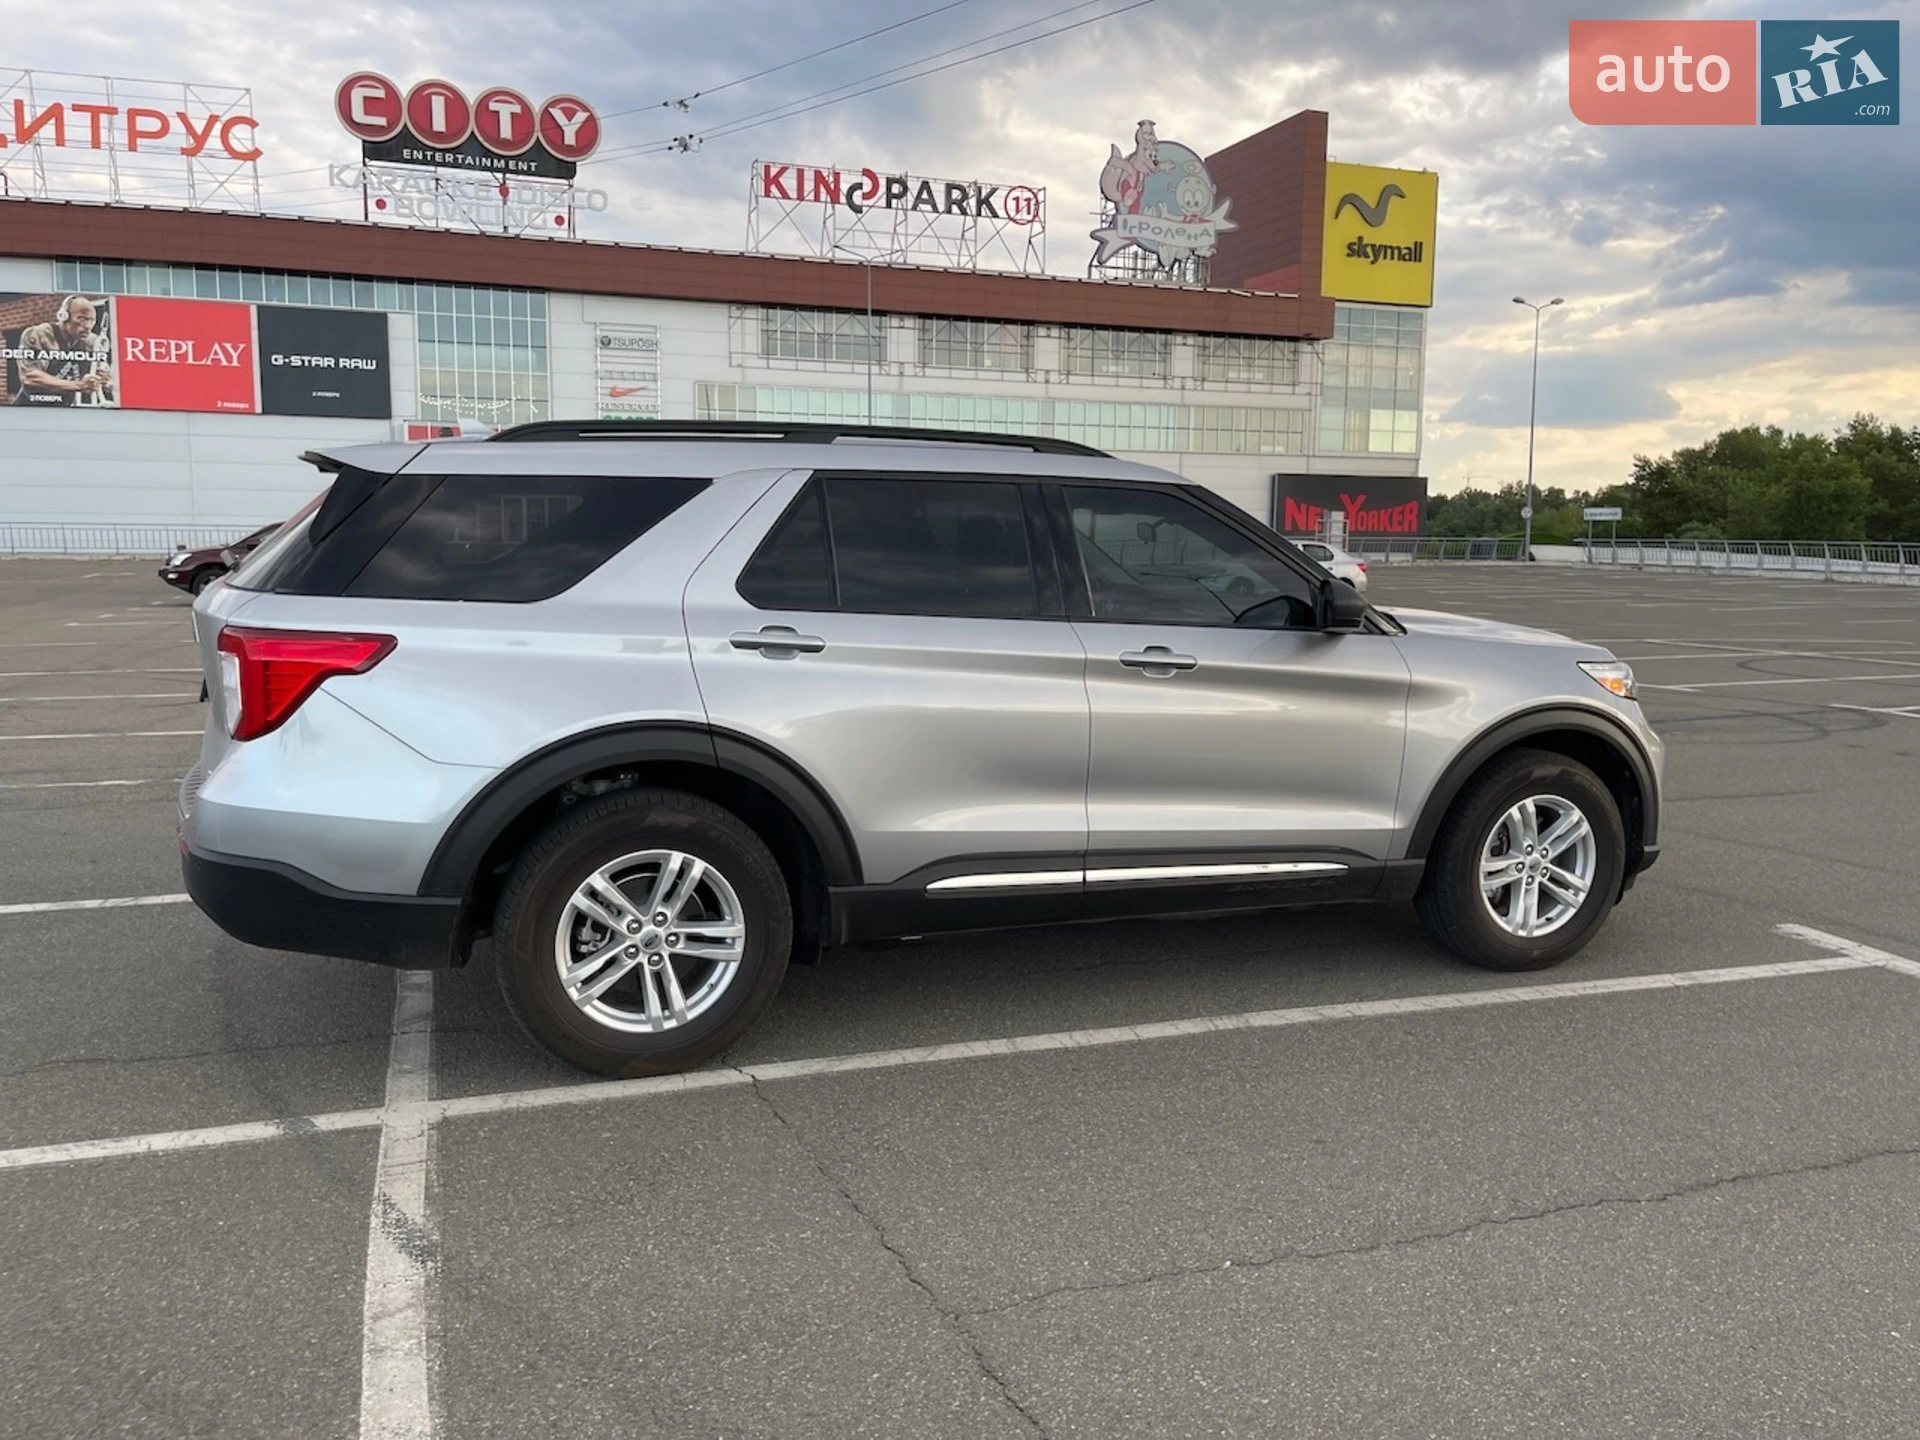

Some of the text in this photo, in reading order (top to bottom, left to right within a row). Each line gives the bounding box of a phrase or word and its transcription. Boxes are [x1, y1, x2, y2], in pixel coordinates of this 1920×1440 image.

[0, 98, 263, 162] ИТРУС
[350, 86, 590, 147] CITY
[402, 148, 539, 172] ENTERTAINMENT
[328, 163, 608, 213] KARAOKE DISCO
[763, 163, 1000, 218] KINOPARK
[394, 193, 548, 230] BOWLING
[1346, 235, 1423, 265] skymall
[0, 348, 108, 361] DER ARMOUR
[124, 336, 247, 367] REPLAY
[270, 354, 377, 370] G-STAR RAW
[1285, 494, 1418, 532] NE YORKER
